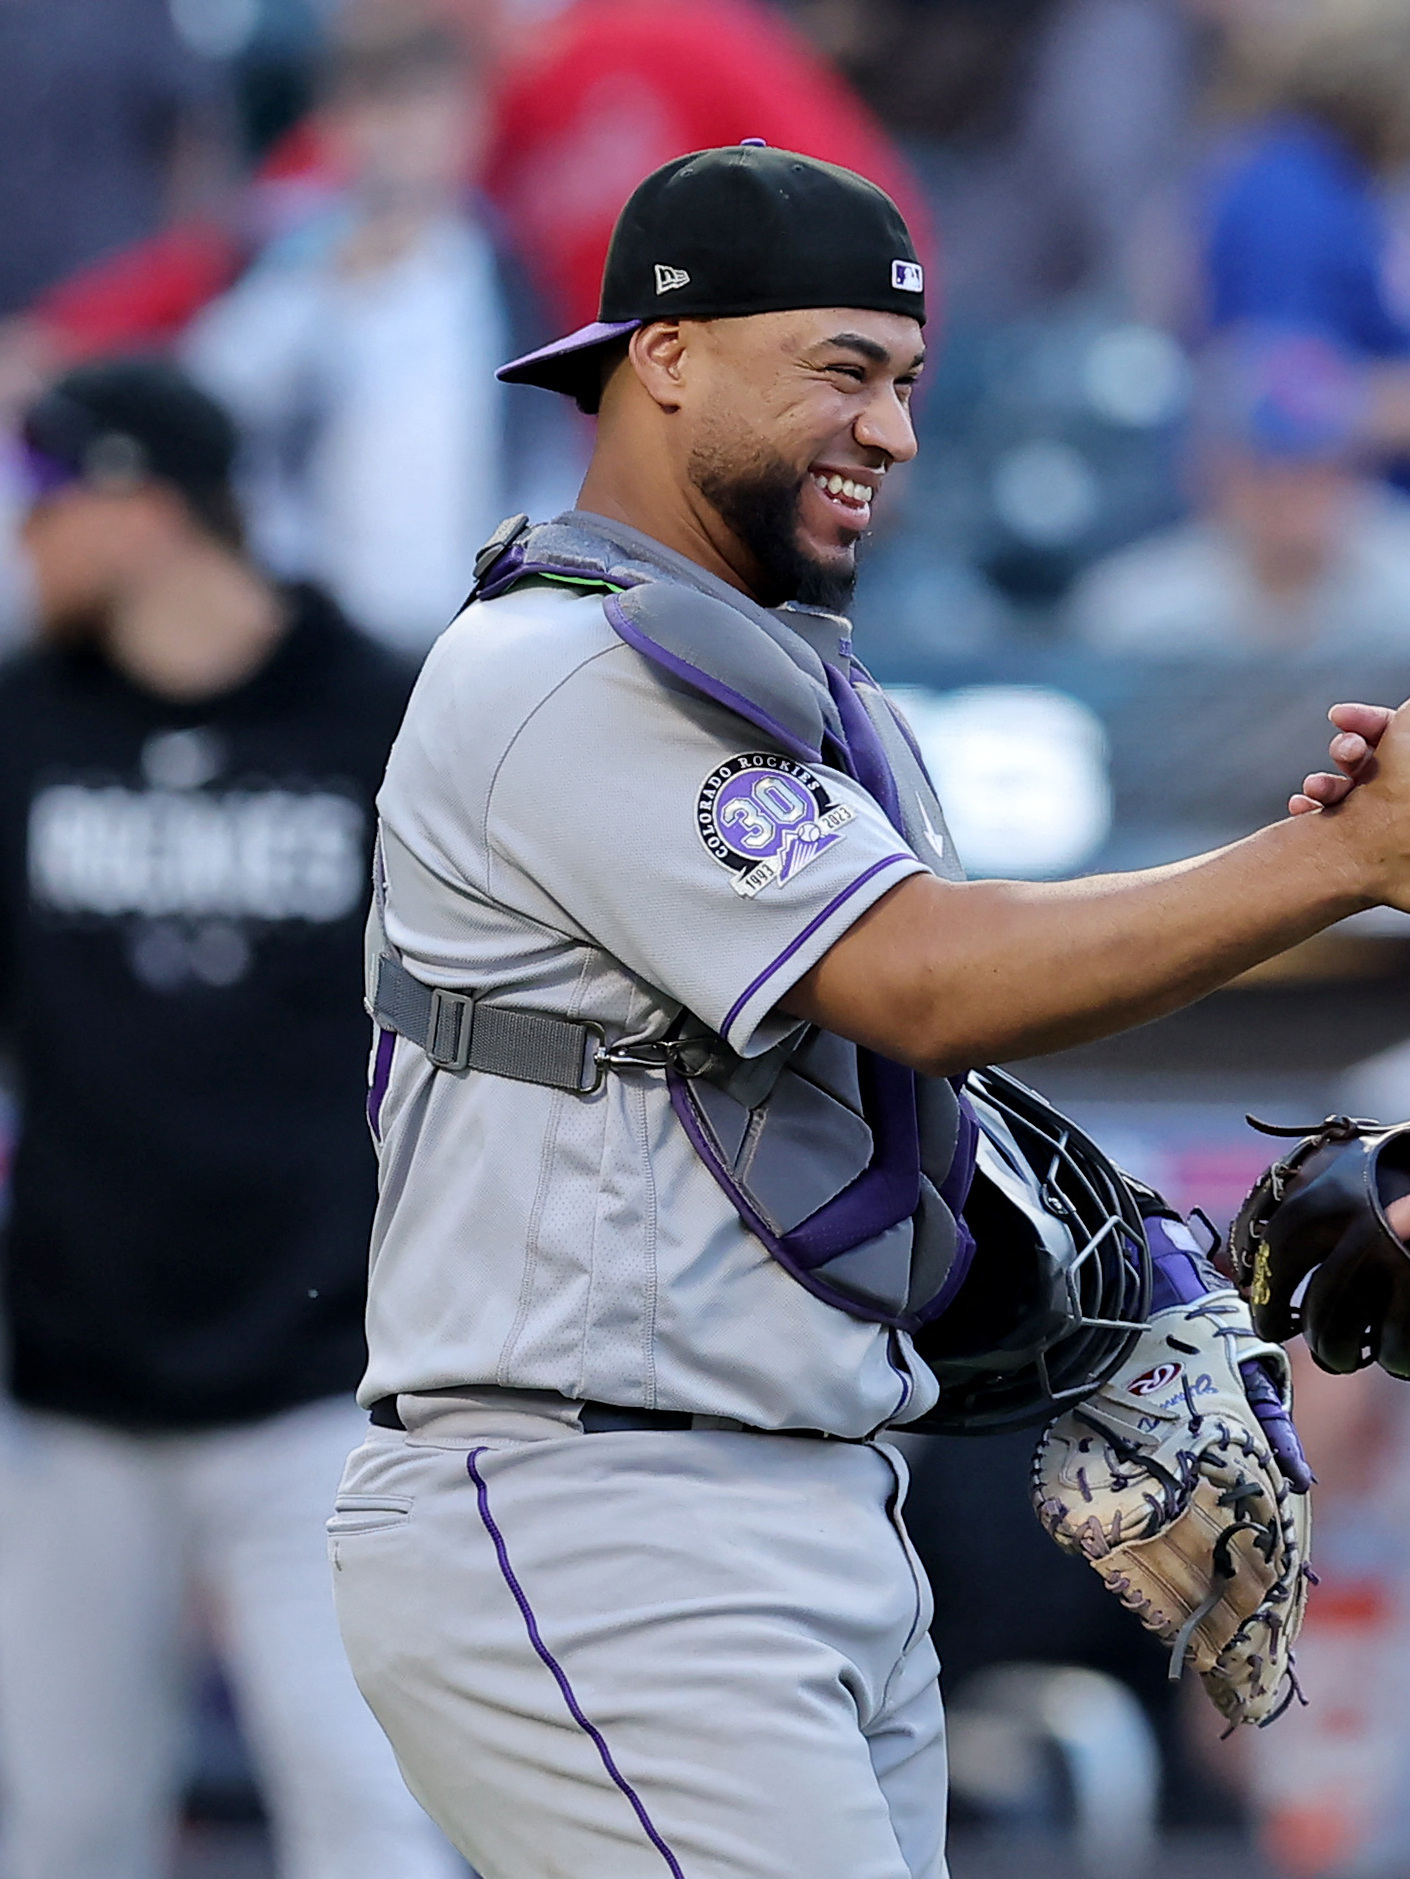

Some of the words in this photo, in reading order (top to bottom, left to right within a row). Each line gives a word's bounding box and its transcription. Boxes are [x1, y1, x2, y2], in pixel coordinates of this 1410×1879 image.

[699, 765, 732, 859] COLORADO
[737, 754, 821, 792] ROCKIES
[720, 775, 807, 849] 30
[822, 807, 853, 829] 2023
[744, 863, 775, 890] 1993
